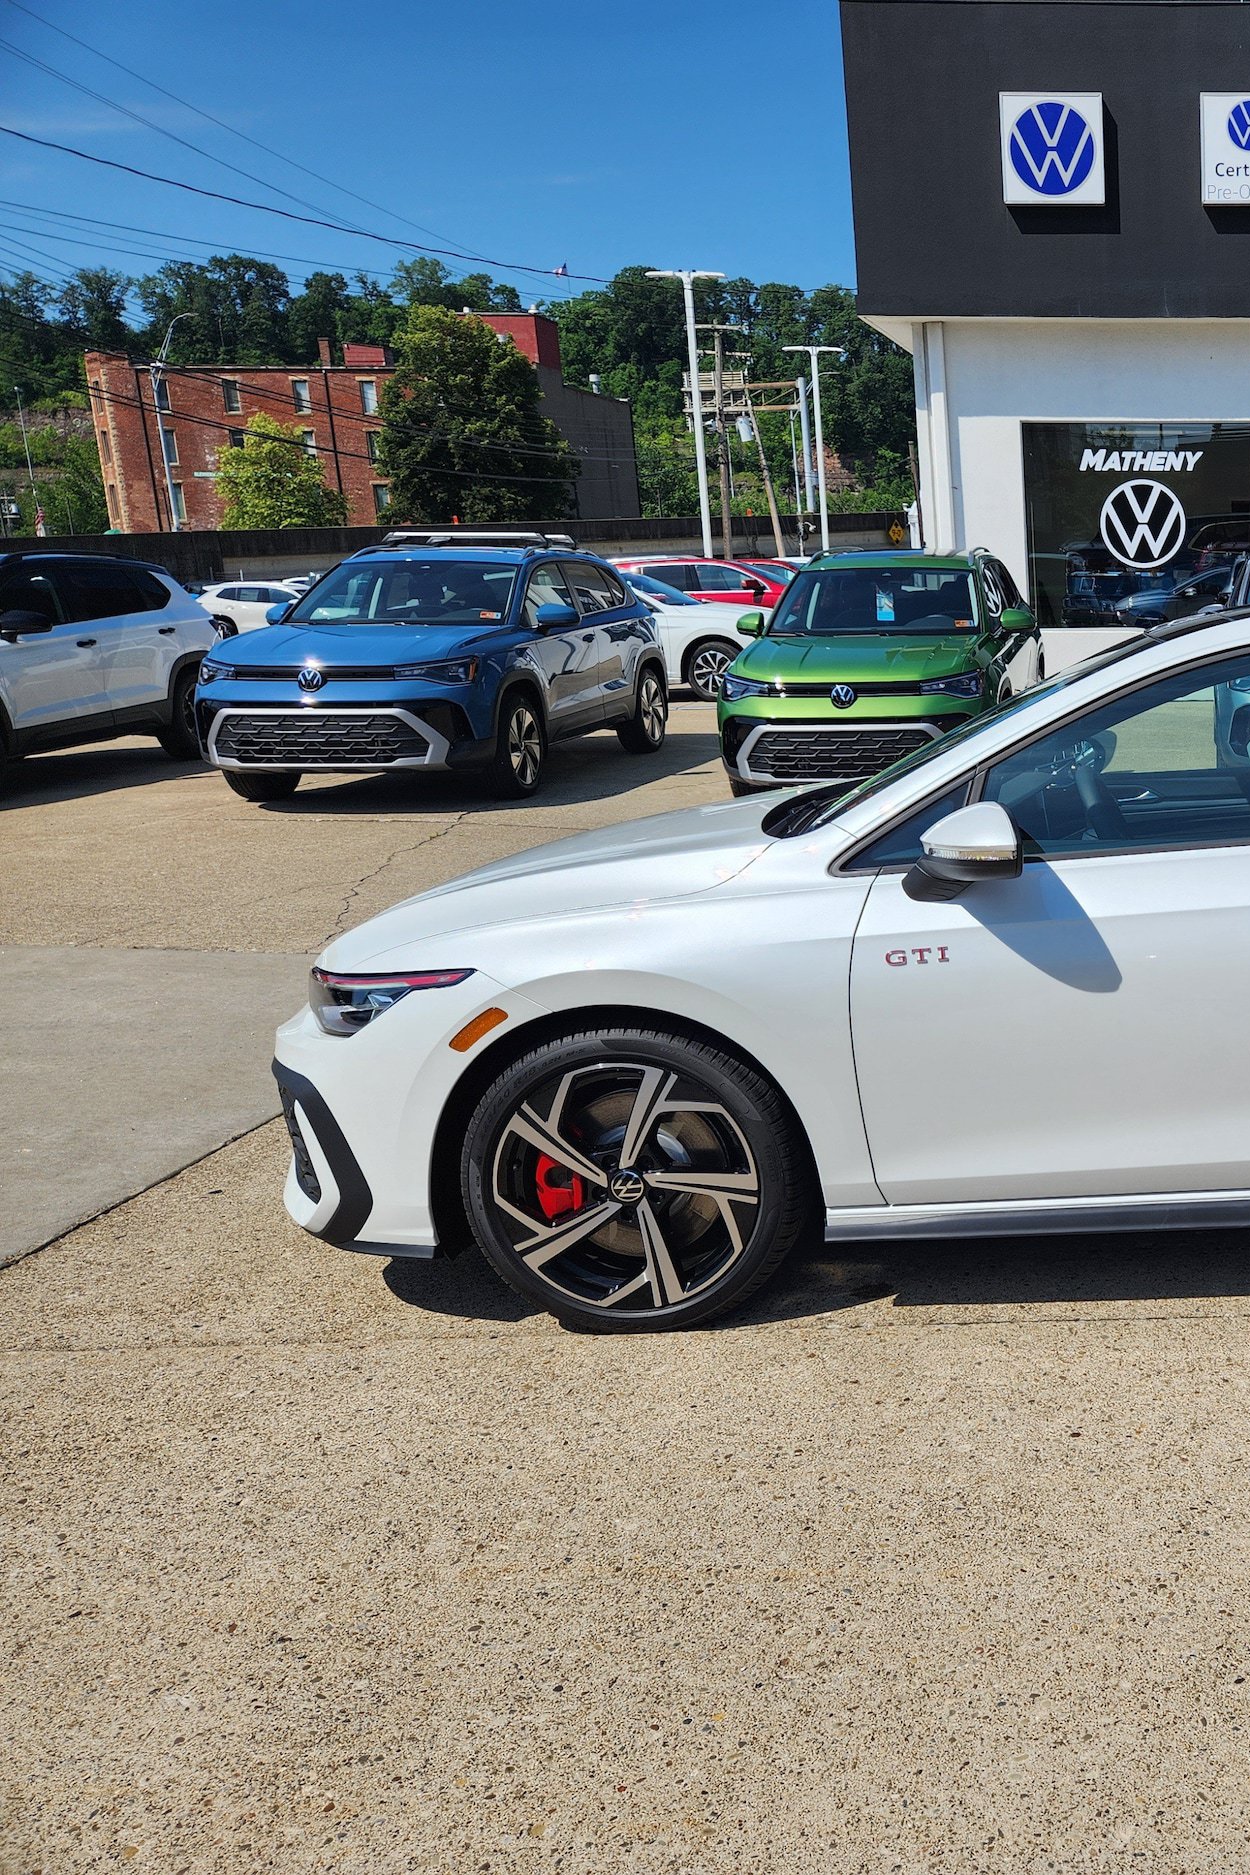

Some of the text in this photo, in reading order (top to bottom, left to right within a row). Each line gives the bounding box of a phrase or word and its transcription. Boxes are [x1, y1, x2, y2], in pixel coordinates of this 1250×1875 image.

[1009, 99, 1097, 195] VW
[1079, 448, 1204, 472] MATHENY
[1100, 478, 1186, 569] VW
[885, 946, 950, 967] GTI
